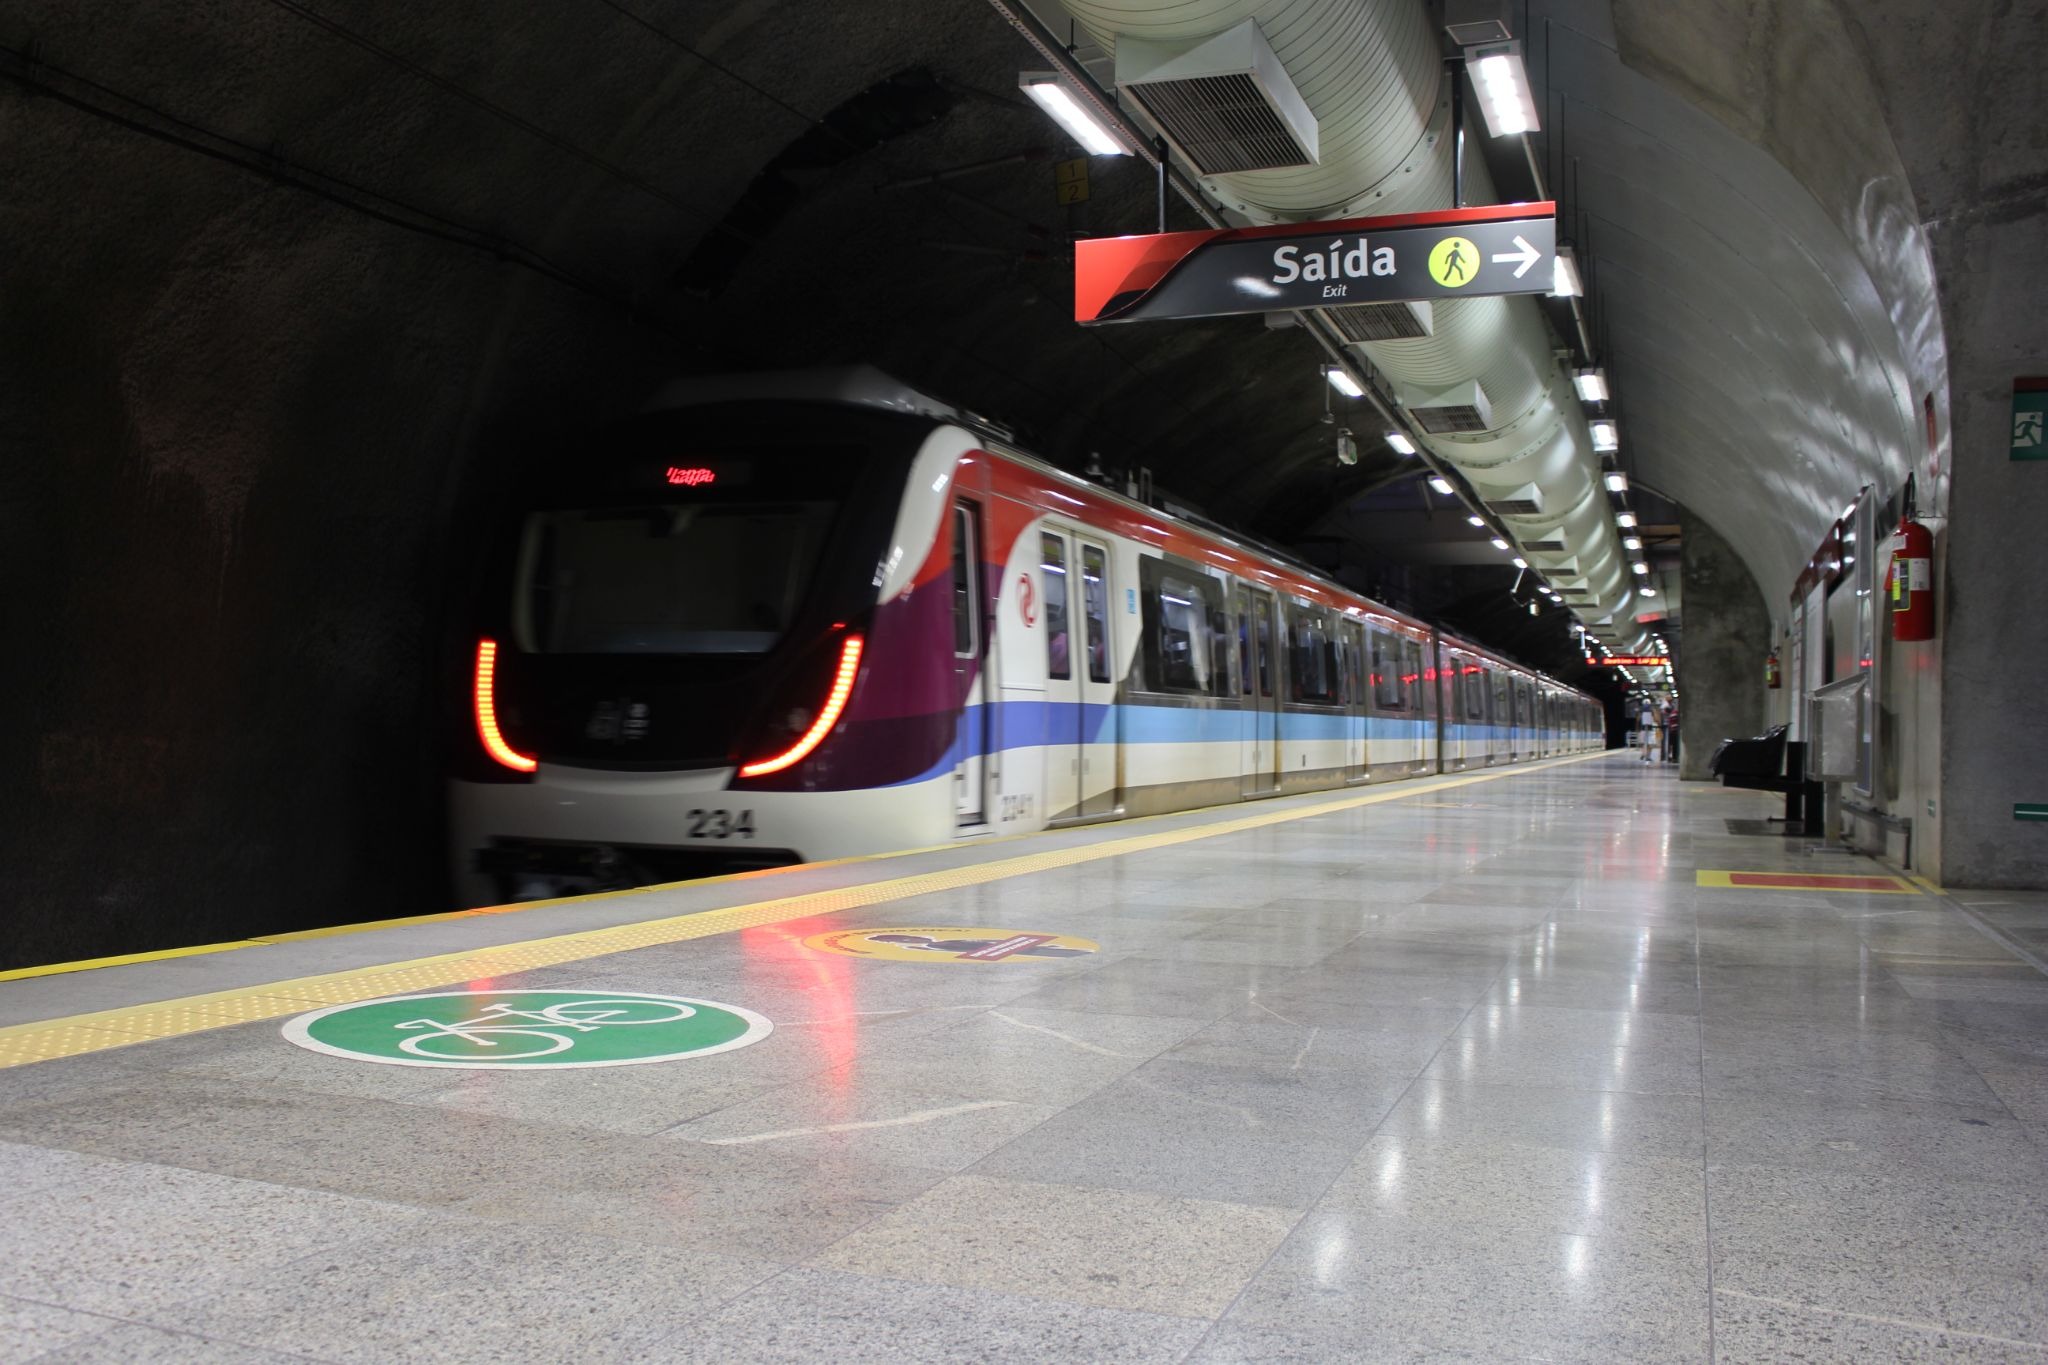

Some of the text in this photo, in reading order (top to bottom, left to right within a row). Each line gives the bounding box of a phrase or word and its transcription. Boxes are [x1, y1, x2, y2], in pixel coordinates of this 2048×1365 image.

[1068, 162, 1076, 178] 1
[1067, 184, 1081, 201] 2
[1273, 238, 1397, 283] Saída
[1322, 285, 1347, 298] Exit
[685, 809, 758, 839] 234
